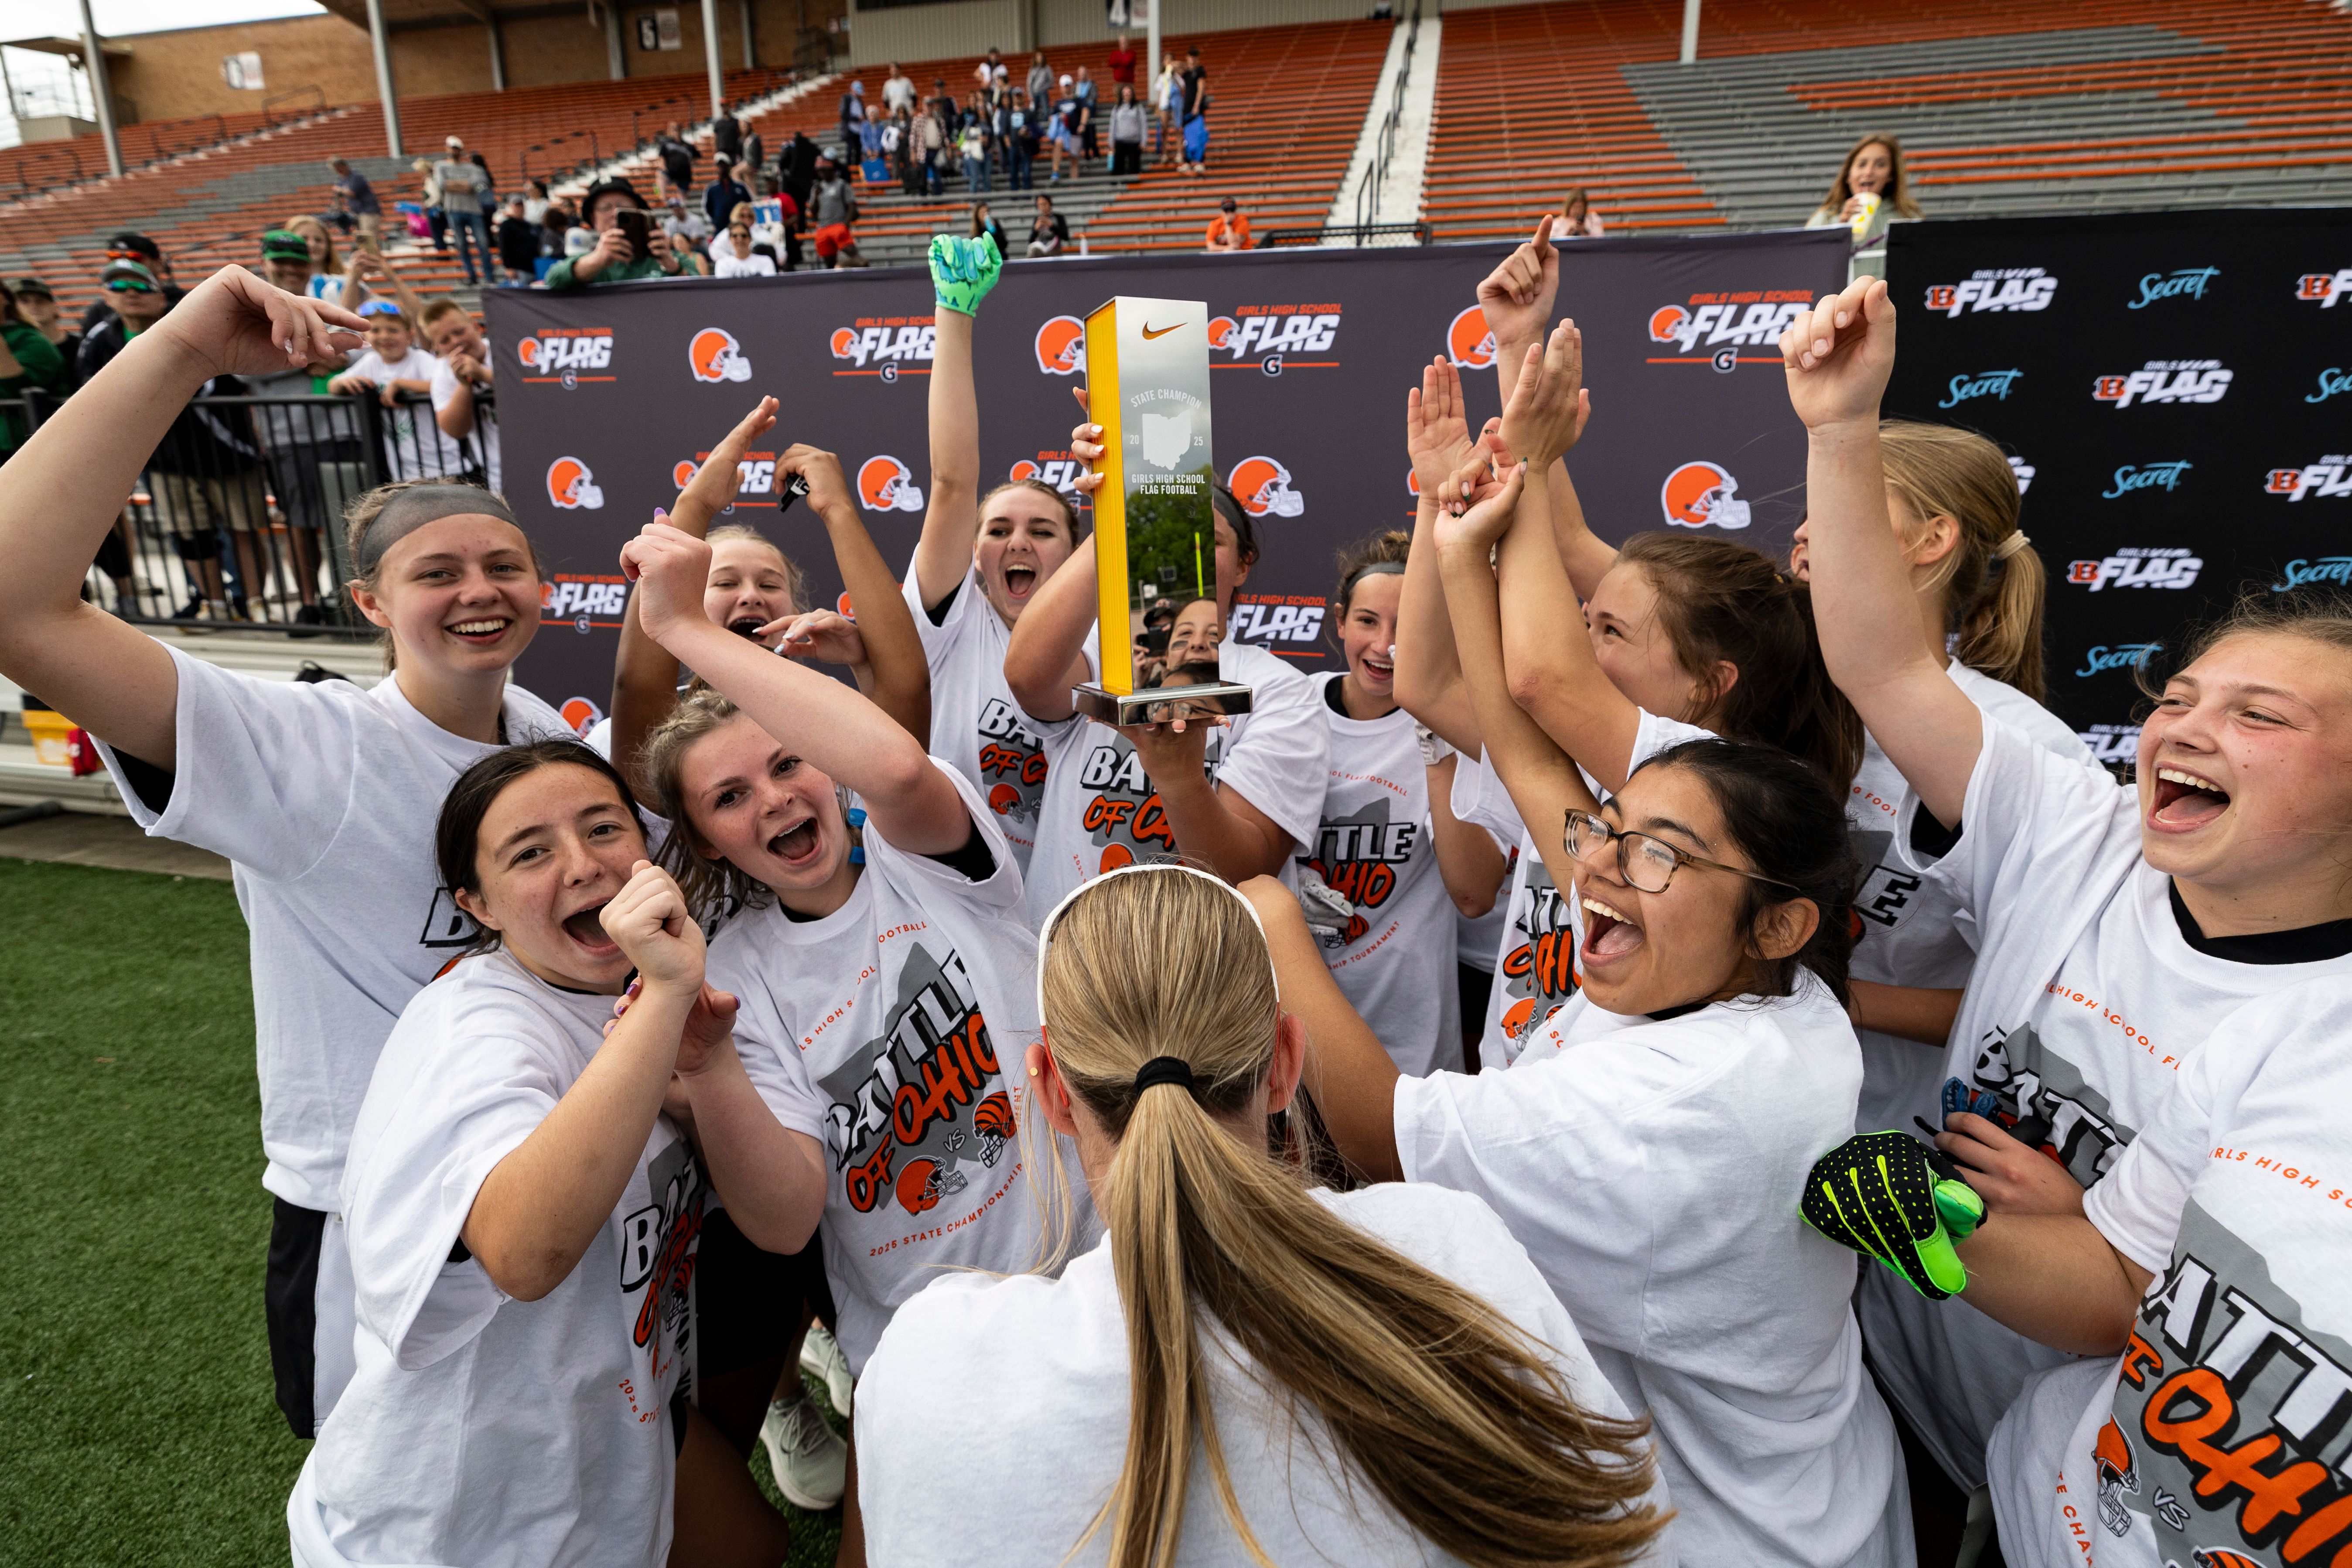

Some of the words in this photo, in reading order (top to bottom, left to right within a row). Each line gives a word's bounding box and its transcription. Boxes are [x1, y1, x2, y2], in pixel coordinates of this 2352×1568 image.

[1947, 277, 2058, 318] FLAG
[2127, 265, 2221, 309] Secret
[1236, 305, 1270, 317] GIRLS
[1269, 304, 1298, 315] HIGH
[1297, 303, 1342, 314] SCHOOL
[539, 336, 614, 376] FLAG
[1232, 314, 1340, 360] FLAG
[1130, 390, 1156, 407] STATE
[1158, 389, 1202, 410] CHAMPION
[1938, 367, 2024, 408] Secret
[2115, 369, 2234, 409] FLAG
[1037, 451, 1067, 460] GIRLS
[1130, 435, 1139, 444] 20
[1194, 436, 1203, 446] 25
[1041, 461, 1089, 495] FL
[1132, 474, 1154, 483] GIRLS
[1156, 474, 1174, 483] HIGH
[1176, 474, 1205, 484] SCHOOL
[1140, 485, 1159, 495] FLAG
[1161, 485, 1198, 495] FOOTBALL
[2102, 459, 2193, 499] Secret
[2287, 464, 2352, 502] FL
[2088, 556, 2204, 592] FLAG
[554, 582, 627, 618] FLAG
[1258, 594, 1285, 605] HIGH
[1285, 595, 1327, 607] SCHOOL
[1230, 604, 1325, 642] FLAG
[2075, 643, 2164, 677] Secret
[1083, 795, 1136, 838] OF
[1308, 822, 1417, 864] TTLE
[878, 921, 927, 943] OOTBALL
[1351, 920, 1400, 963] TOURNAMENT
[814, 1008, 844, 1035] HIGH
[2056, 985, 2099, 1009] HIGH
[2103, 1007, 2155, 1055] SCHOOL
[943, 1128, 966, 1153] VS
[846, 1131, 896, 1213] OF
[2255, 1156, 2320, 1189] HIGH
[870, 1239, 898, 1257] 2025
[903, 1227, 943, 1245] STATE
[946, 1162, 1024, 1233] CHAMPIONSHIP
[2152, 1485, 2192, 1532] VS
